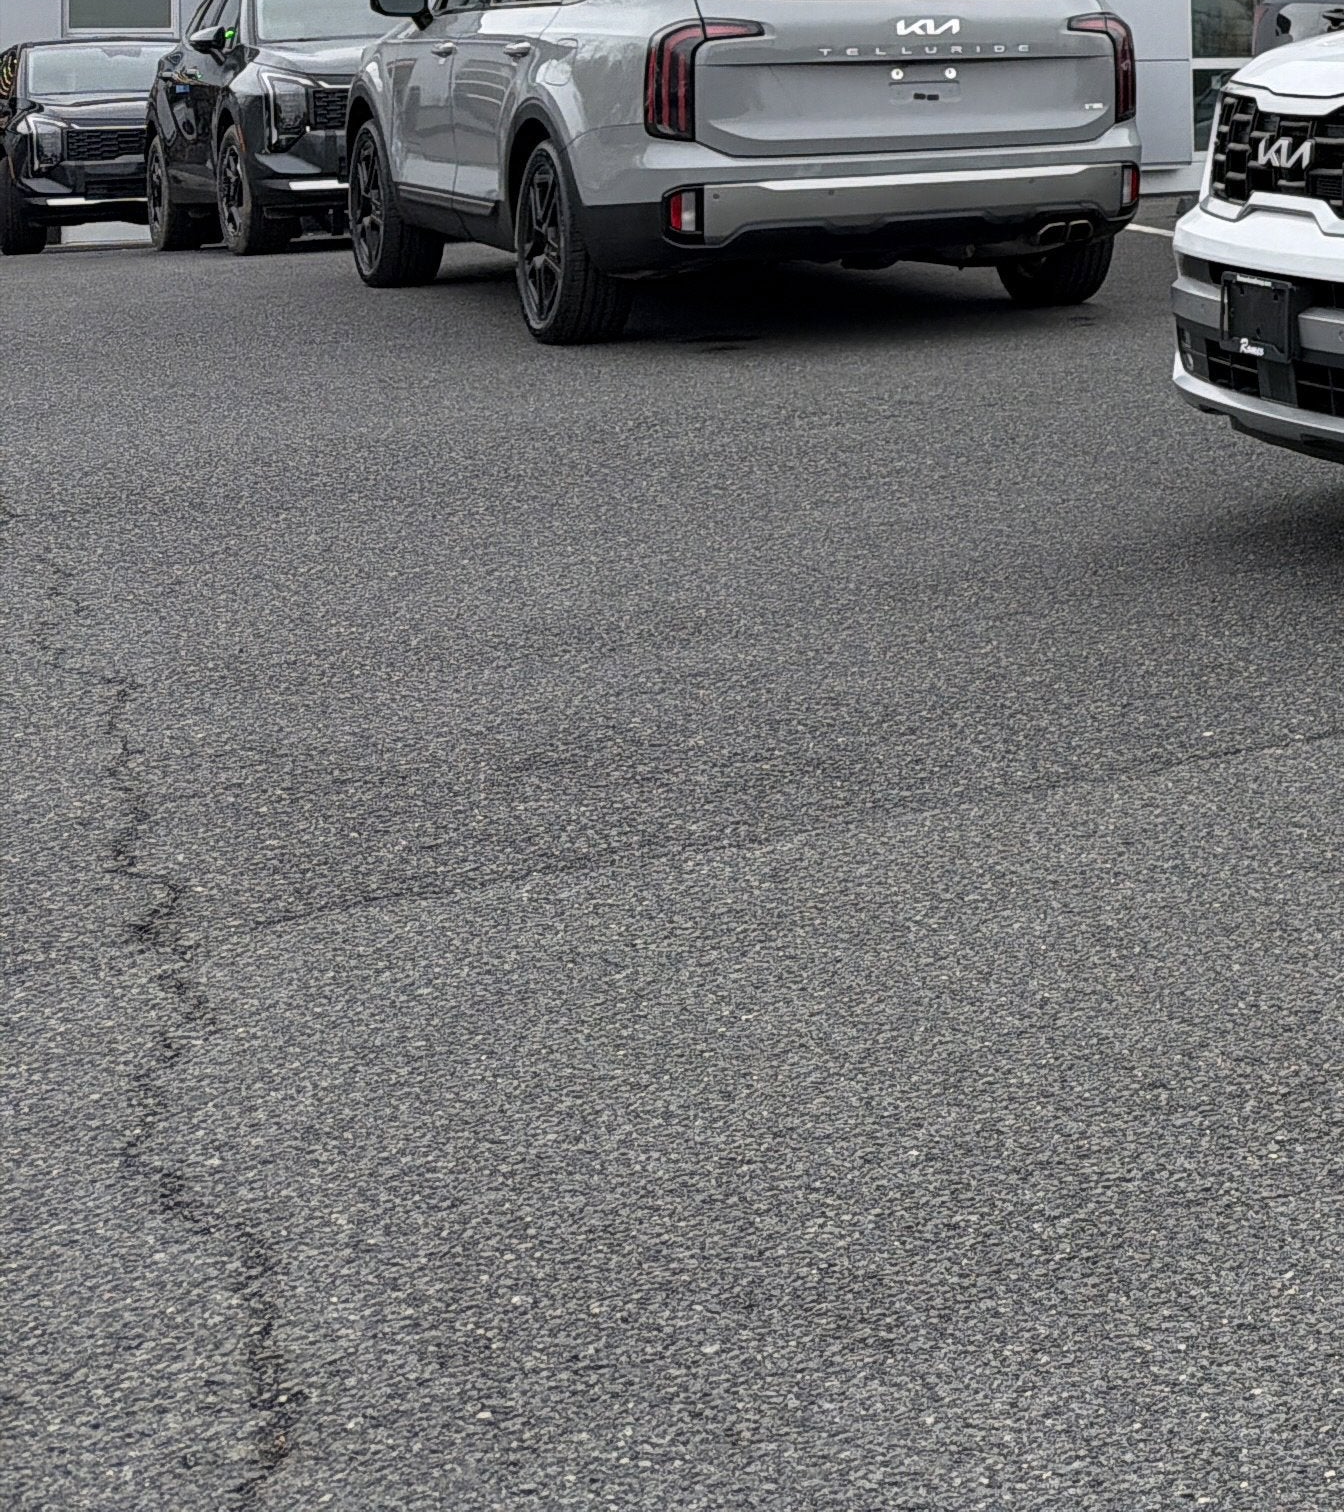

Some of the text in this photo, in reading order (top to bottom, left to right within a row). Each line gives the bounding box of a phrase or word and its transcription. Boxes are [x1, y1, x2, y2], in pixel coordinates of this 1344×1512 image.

[896, 18, 961, 36] KIA
[818, 44, 1030, 57] TELLURIDE
[1258, 136, 1314, 169] KIA
